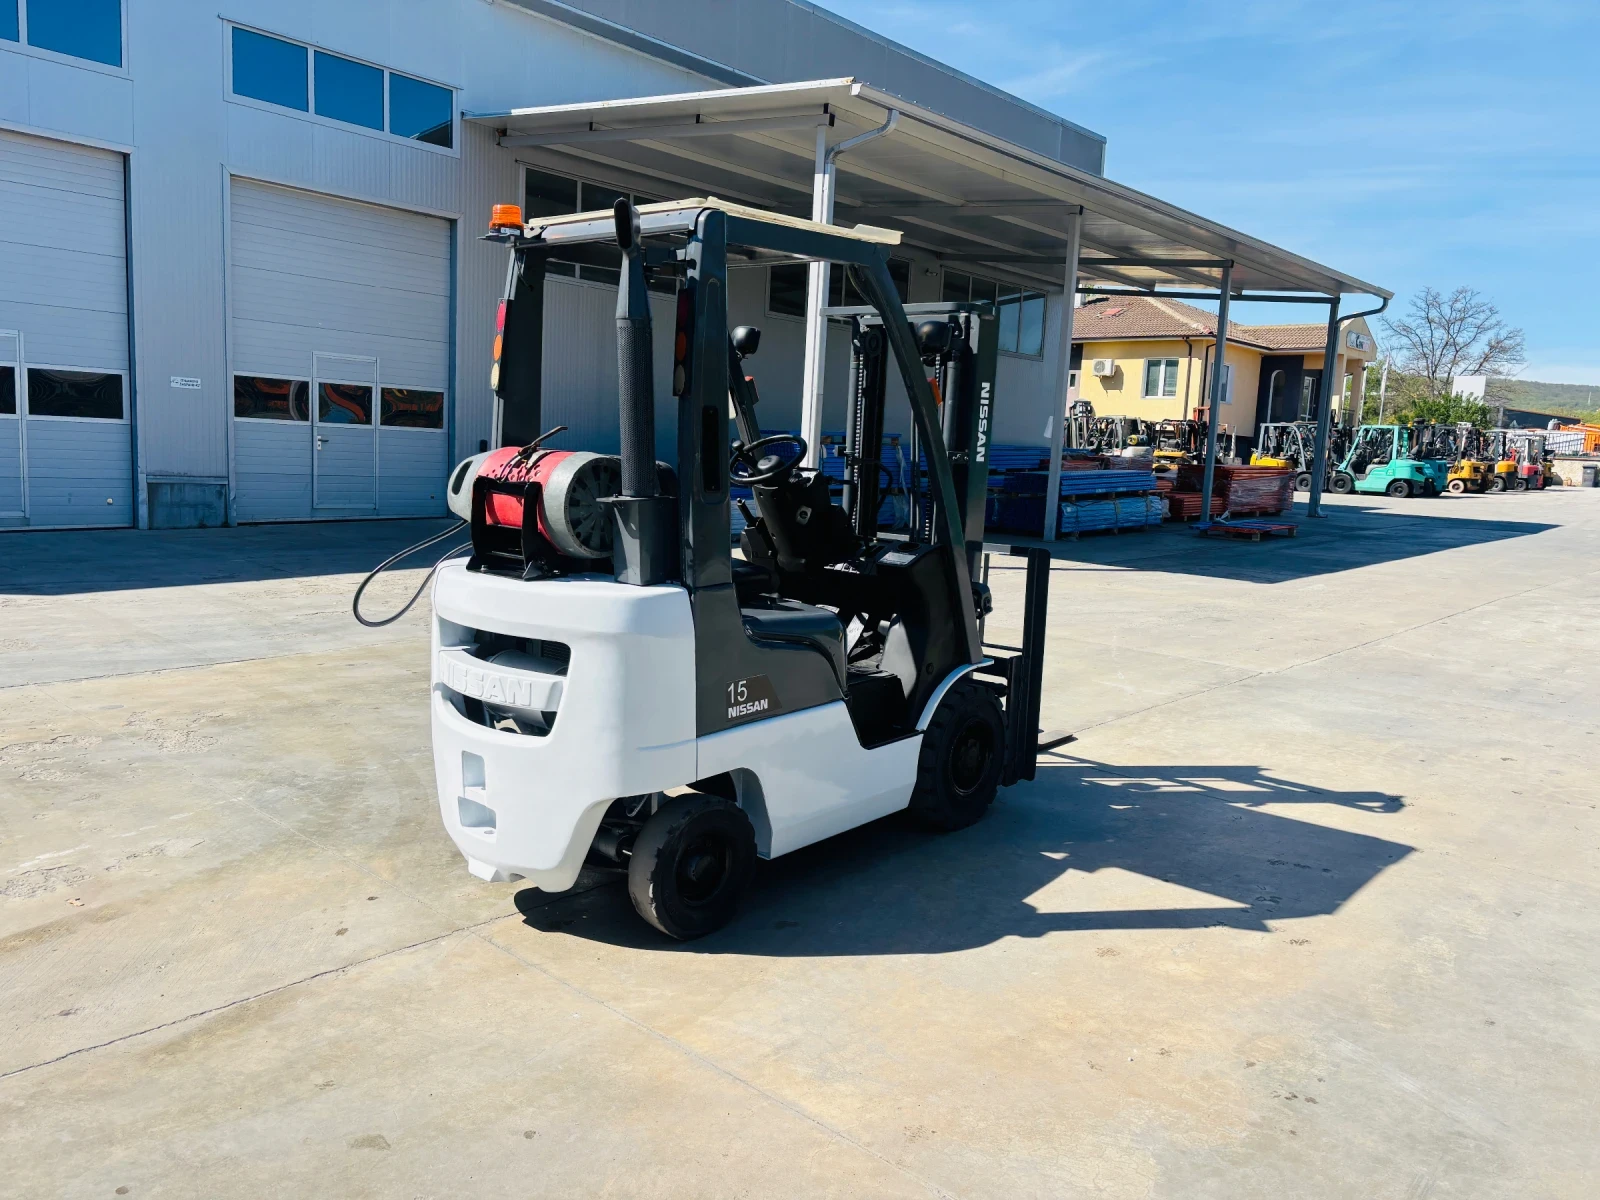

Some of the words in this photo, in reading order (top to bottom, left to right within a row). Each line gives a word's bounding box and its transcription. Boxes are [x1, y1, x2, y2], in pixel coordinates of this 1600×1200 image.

[975, 382, 991, 462] NISSAN
[439, 656, 531, 706] NISSAN
[727, 680, 748, 704] 15
[727, 698, 769, 719] NISSAN
